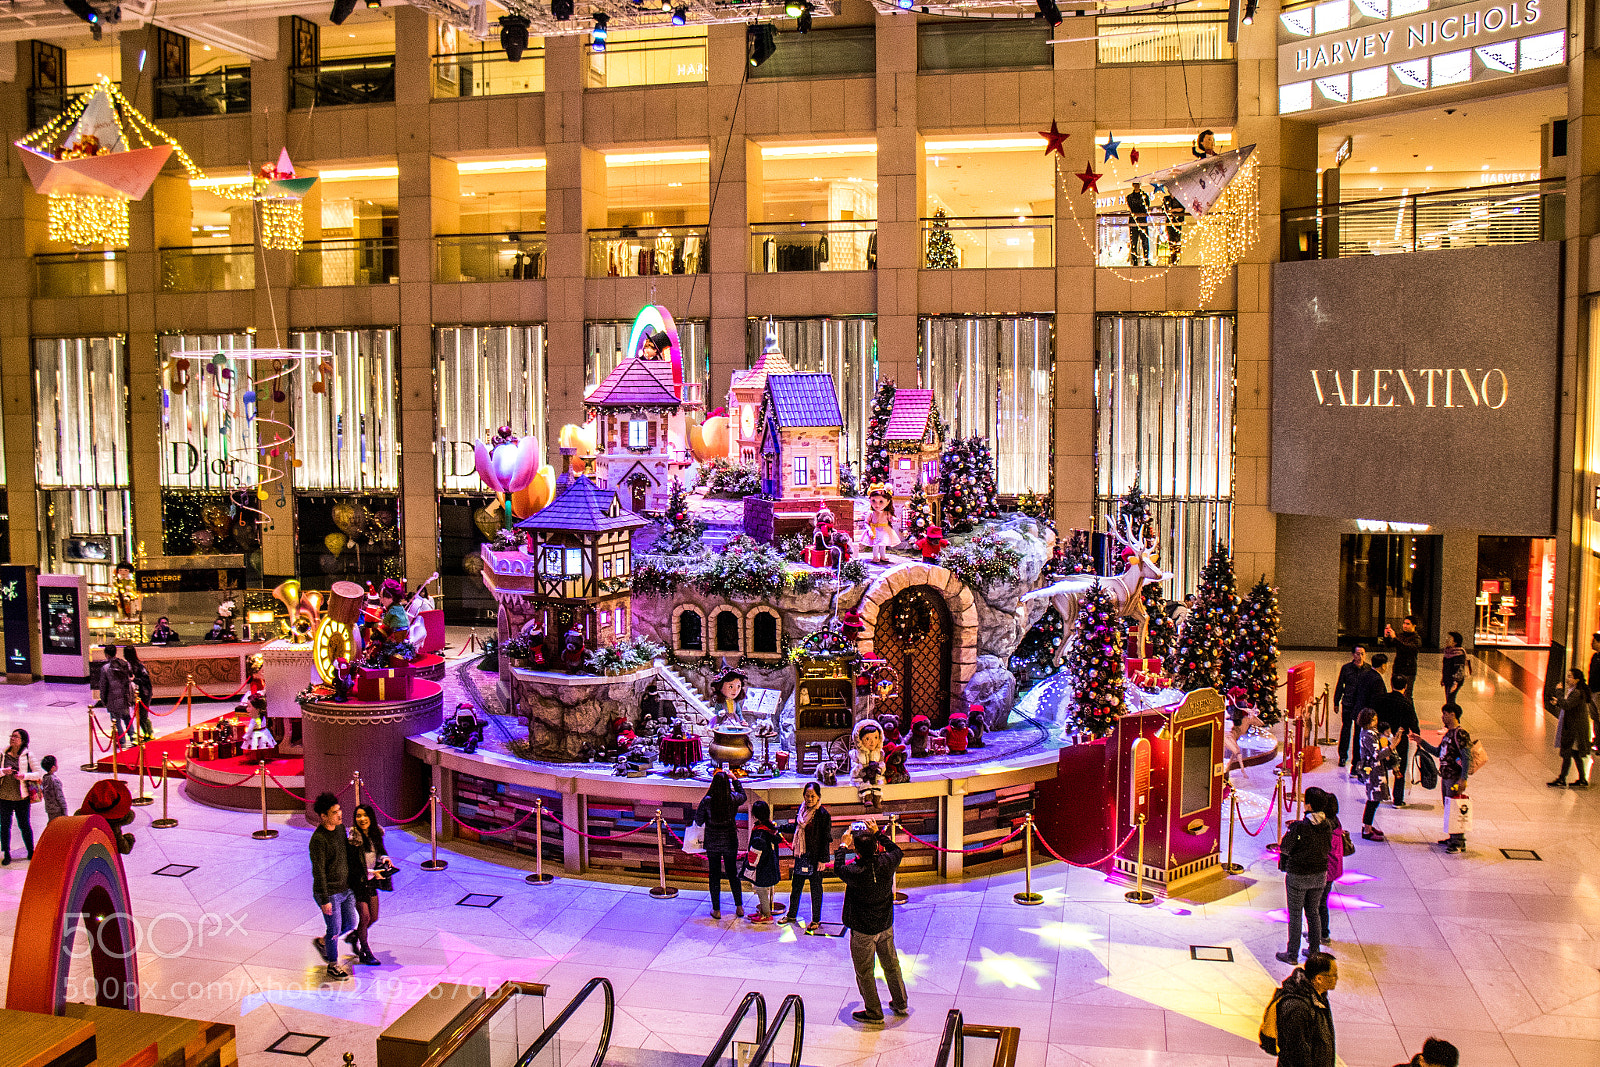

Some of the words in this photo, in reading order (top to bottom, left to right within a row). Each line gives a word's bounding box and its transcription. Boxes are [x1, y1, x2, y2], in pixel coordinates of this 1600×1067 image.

[1296, 30, 1394, 72] HARVEY
[1407, 0, 1543, 49] NICHOLS
[1480, 173, 1526, 184] HARVEY
[1310, 368, 1508, 409] VALENTINO
[169, 441, 240, 476] Dior
